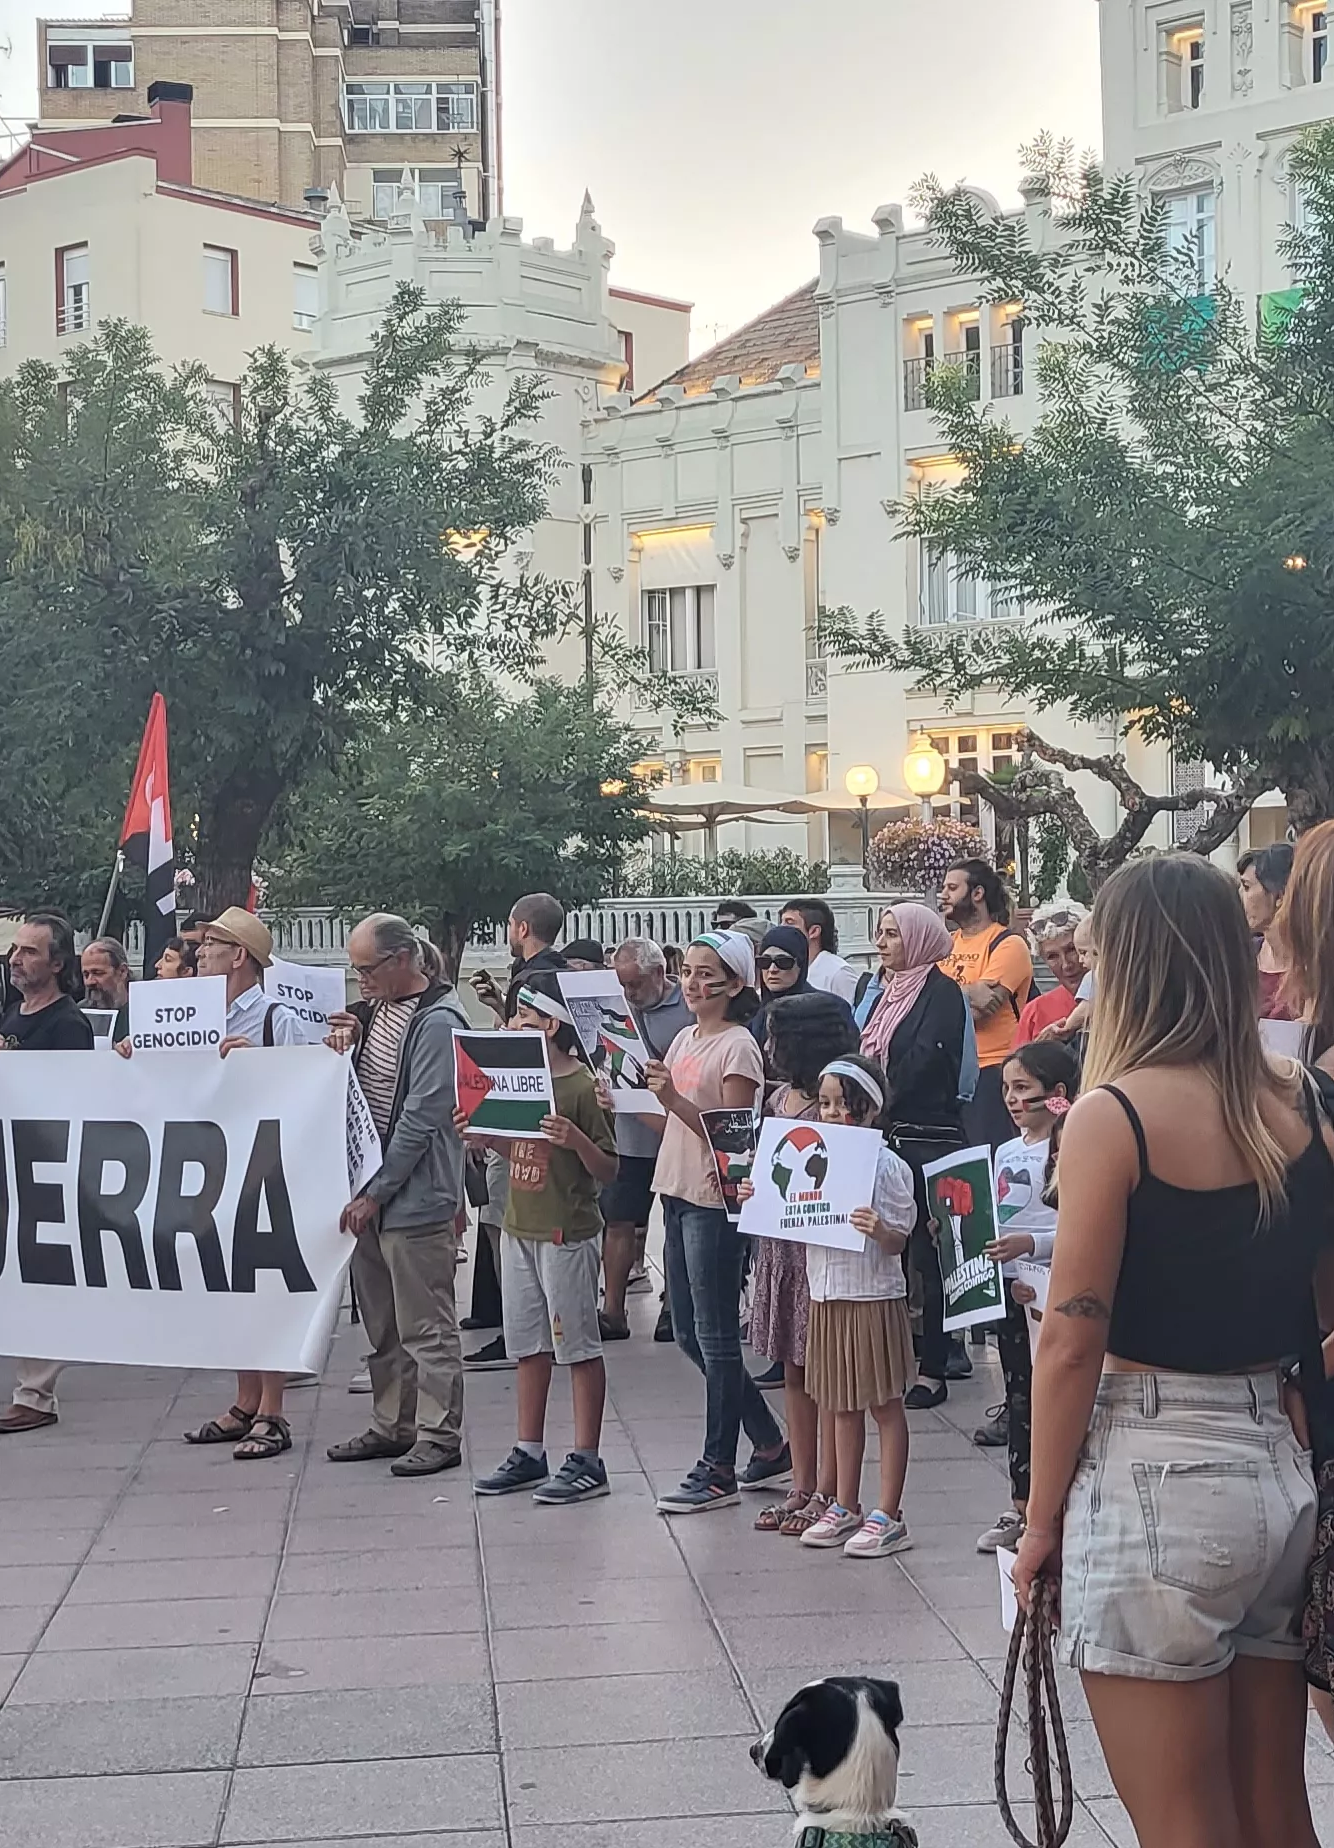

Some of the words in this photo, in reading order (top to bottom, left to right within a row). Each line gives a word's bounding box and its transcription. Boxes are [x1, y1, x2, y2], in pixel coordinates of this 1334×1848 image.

[276, 983, 314, 1002] STOP
[154, 1006, 197, 1024] STOP
[133, 1029, 220, 1049] GENOCIDIO
[510, 1075, 545, 1093] LIBRE
[363, 1113, 377, 1144] THE
[789, 1192, 796, 1203] EL
[798, 1190, 822, 1202] MUNDO
[785, 1204, 802, 1216] ESTA
[802, 1202, 831, 1214] CONTIGO
[780, 1216, 805, 1229] FUERZA
